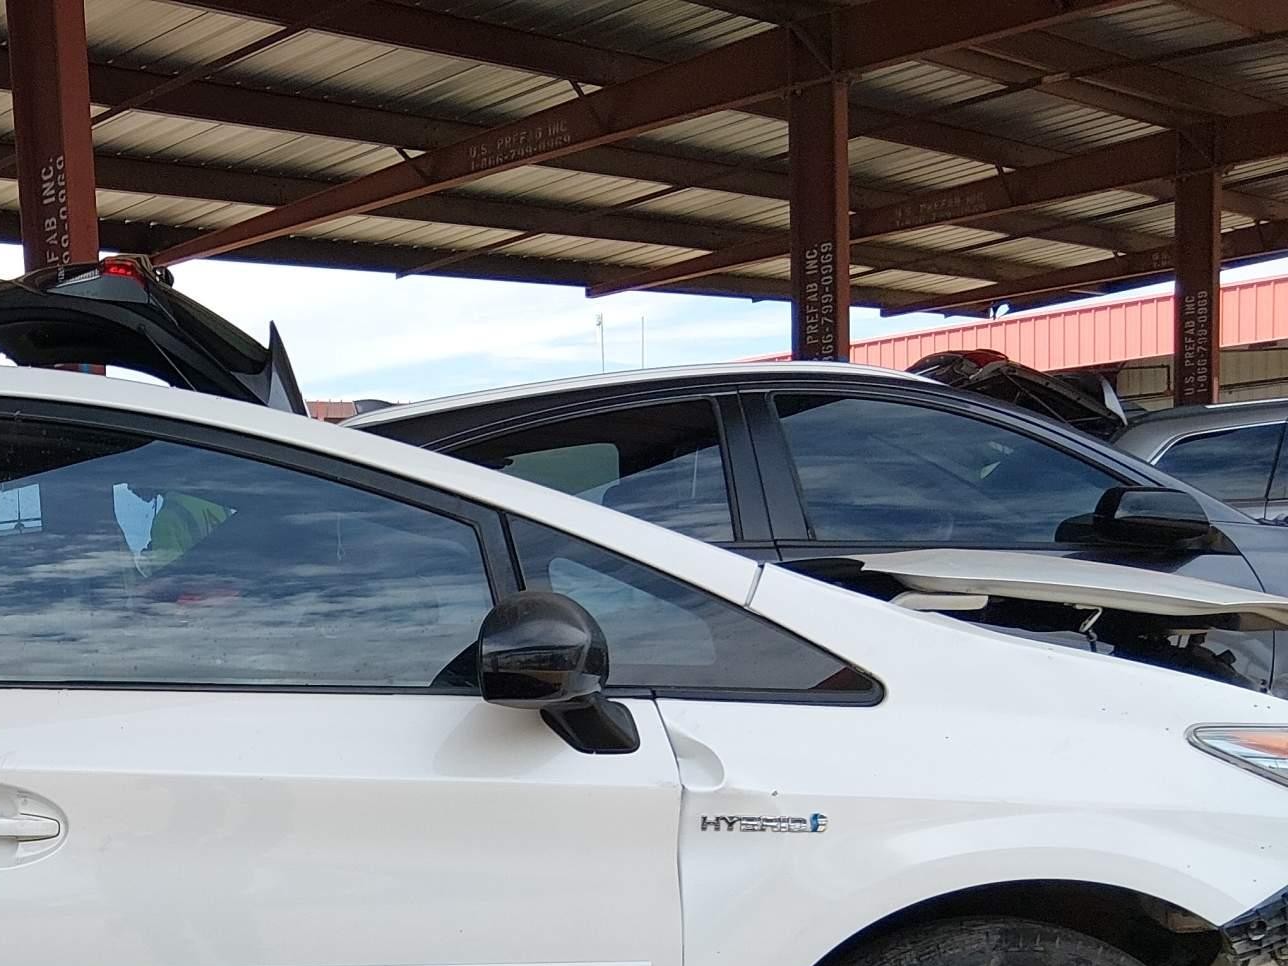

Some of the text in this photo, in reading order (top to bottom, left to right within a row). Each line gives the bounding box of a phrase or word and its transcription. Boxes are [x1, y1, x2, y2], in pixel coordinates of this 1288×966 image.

[40, 157, 59, 264] FAB INC.
[805, 243, 819, 276] INC.
[806, 281, 819, 345] PREFAB
[1184, 319, 1196, 368] PREFAB
[700, 814, 809, 833] HYBRID
